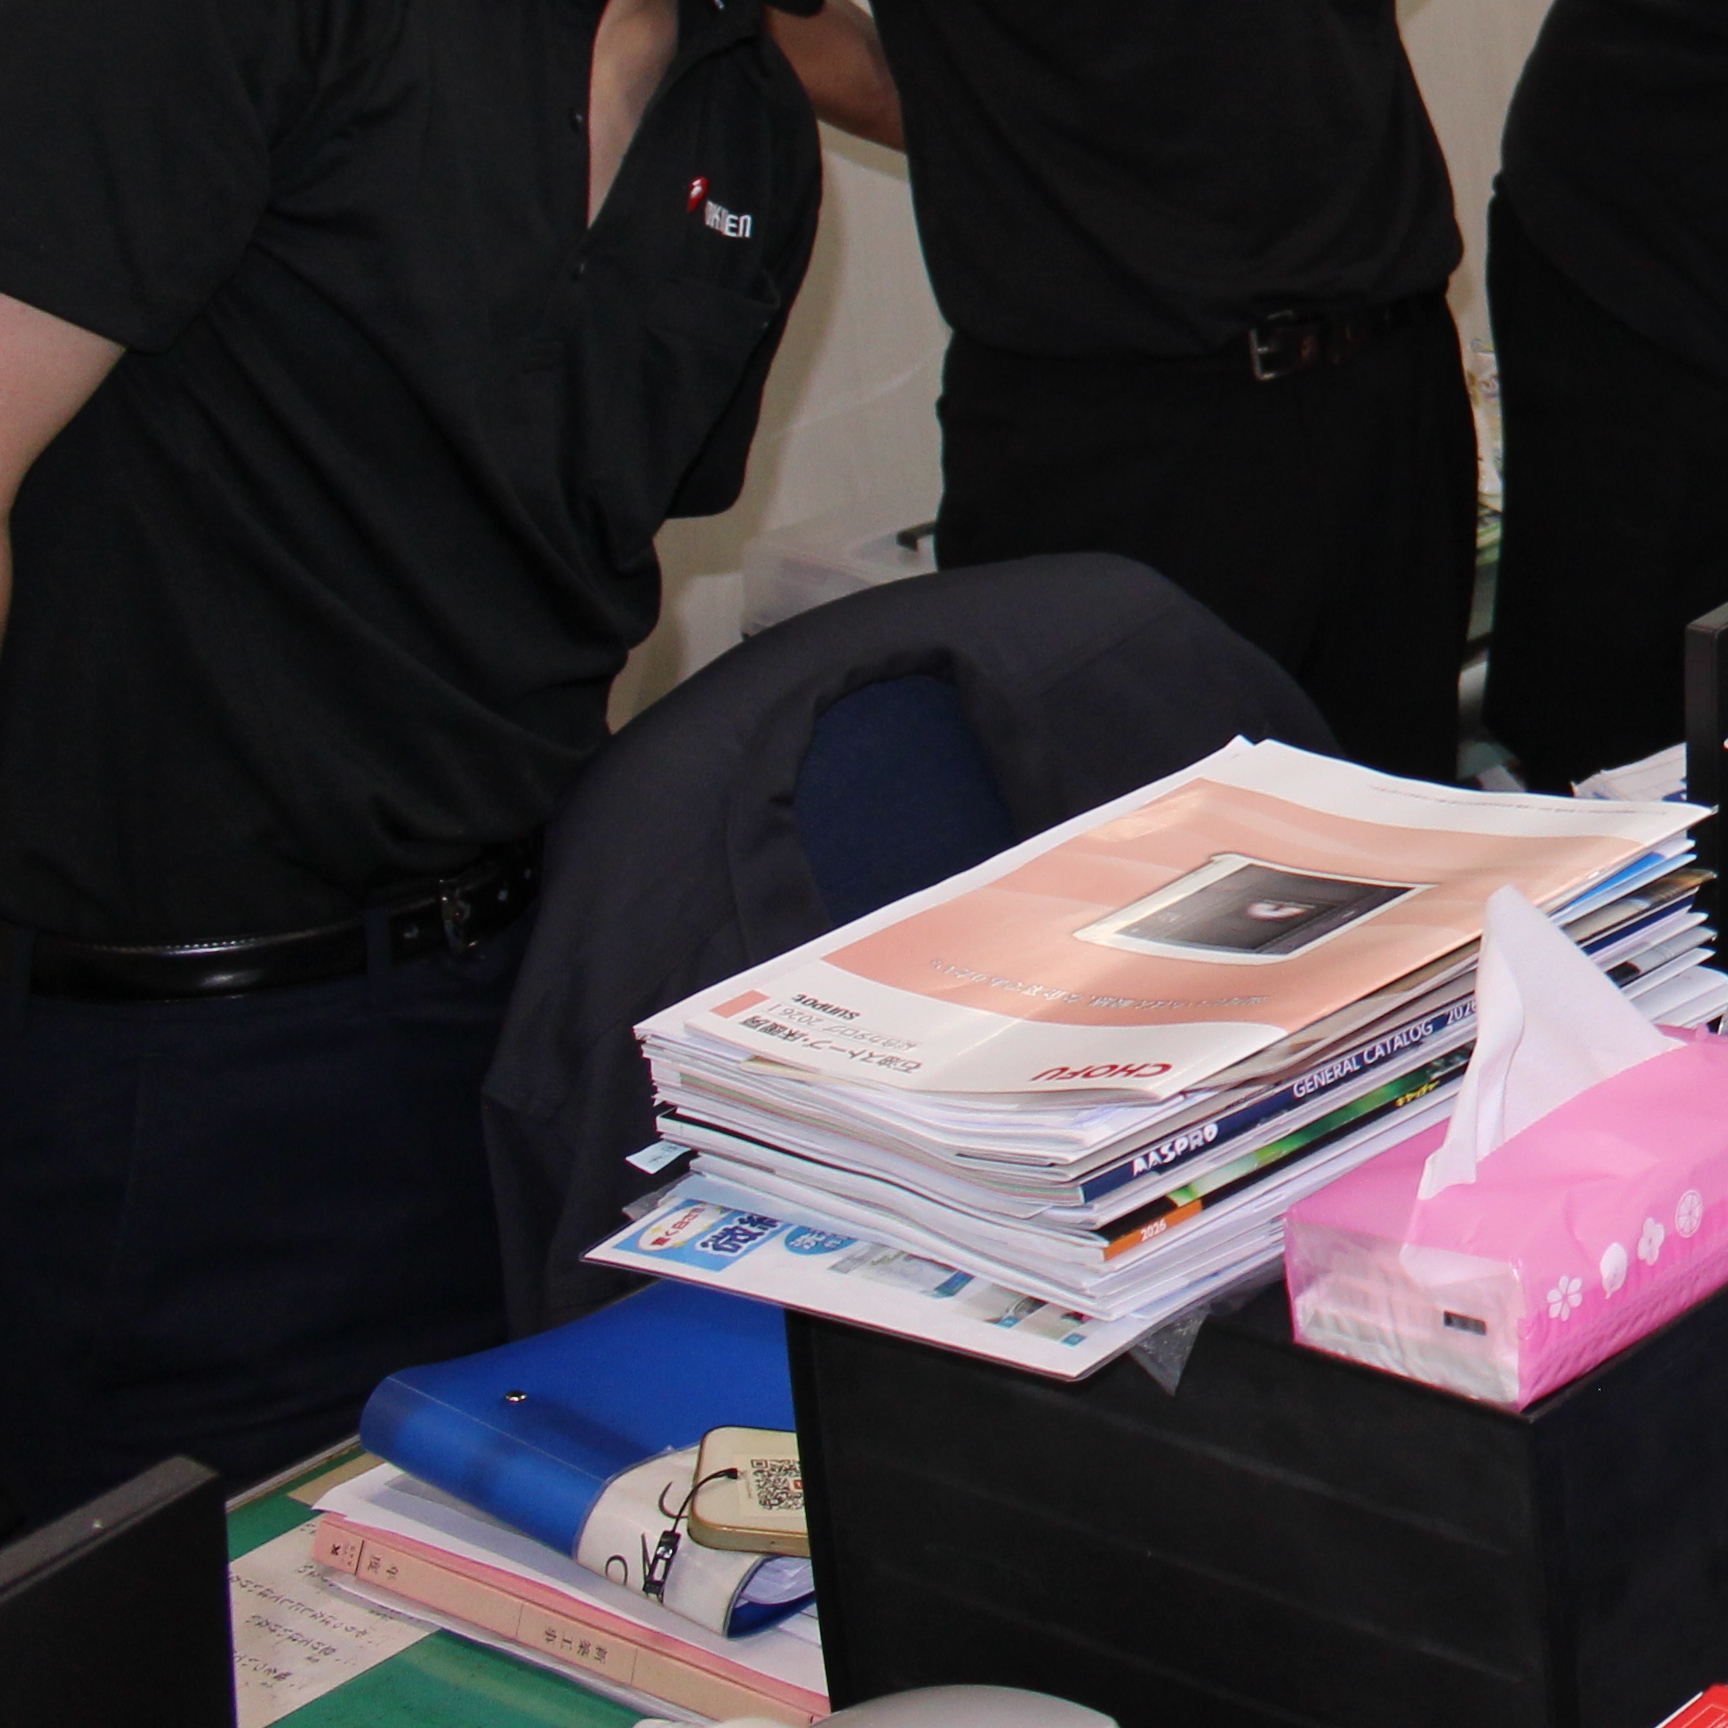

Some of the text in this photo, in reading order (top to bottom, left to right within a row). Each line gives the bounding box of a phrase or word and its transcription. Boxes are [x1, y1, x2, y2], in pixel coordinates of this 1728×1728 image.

[1292, 1056, 1361, 1100] GENERAL
[1362, 1020, 1435, 1066] CATALOG
[1031, 1061, 1174, 1083] CHOFU
[1140, 1219, 1168, 1242] 2026
